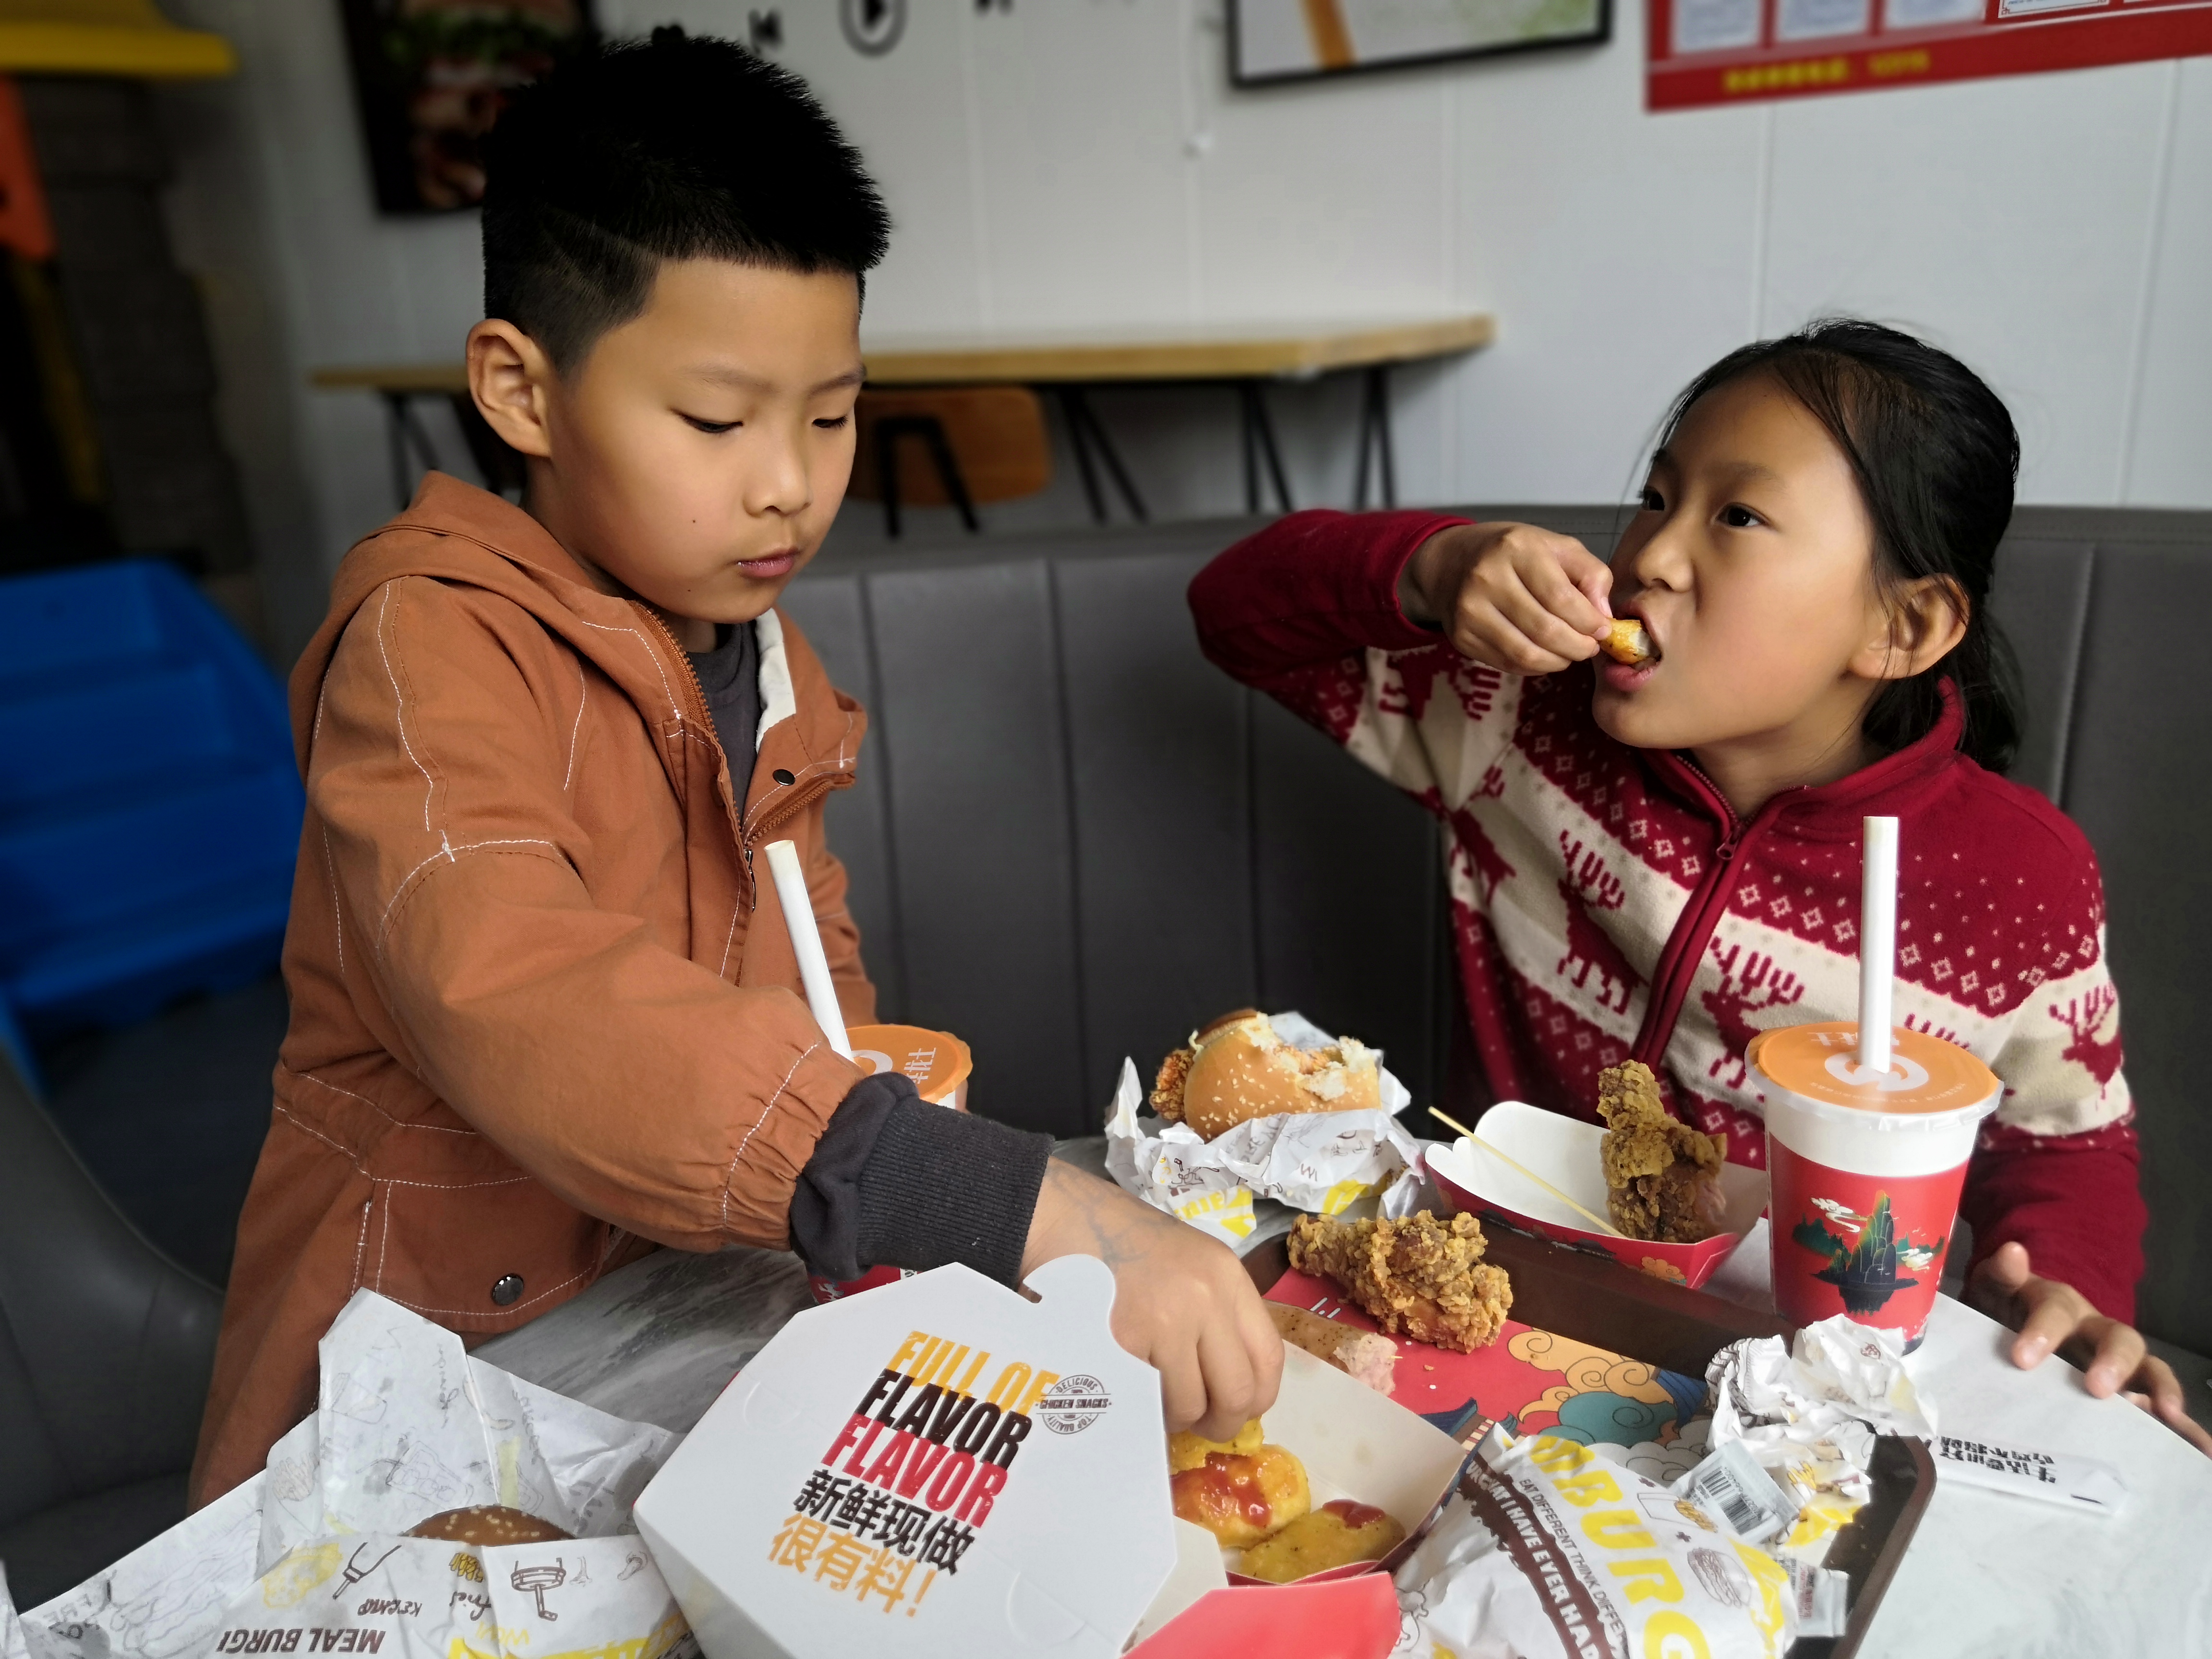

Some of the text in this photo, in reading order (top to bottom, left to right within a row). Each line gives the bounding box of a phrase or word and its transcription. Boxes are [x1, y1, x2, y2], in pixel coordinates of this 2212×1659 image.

[855, 1368, 1032, 1470] FLAVOR
[887, 1330, 1060, 1416] FULL OF
[1056, 1377, 1098, 1393] DELICIOUS
[1075, 1398, 1109, 1409] SNACKS
[821, 1413, 1008, 1528] FLAVOR
[1047, 1416, 1092, 1432] TOP QUALITY
[768, 1512, 938, 1617] 很有料!
[793, 1469, 975, 1575] 新鲜现做
[1505, 1505, 1544, 1549] HAVE
[1532, 1549, 1570, 1604] EVER
[1518, 1478, 1539, 1494] EAT
[1531, 1493, 1577, 1549] DIFFERENT
[1571, 1552, 1600, 1589] THINK
[307, 1627, 386, 1654] MEAL
